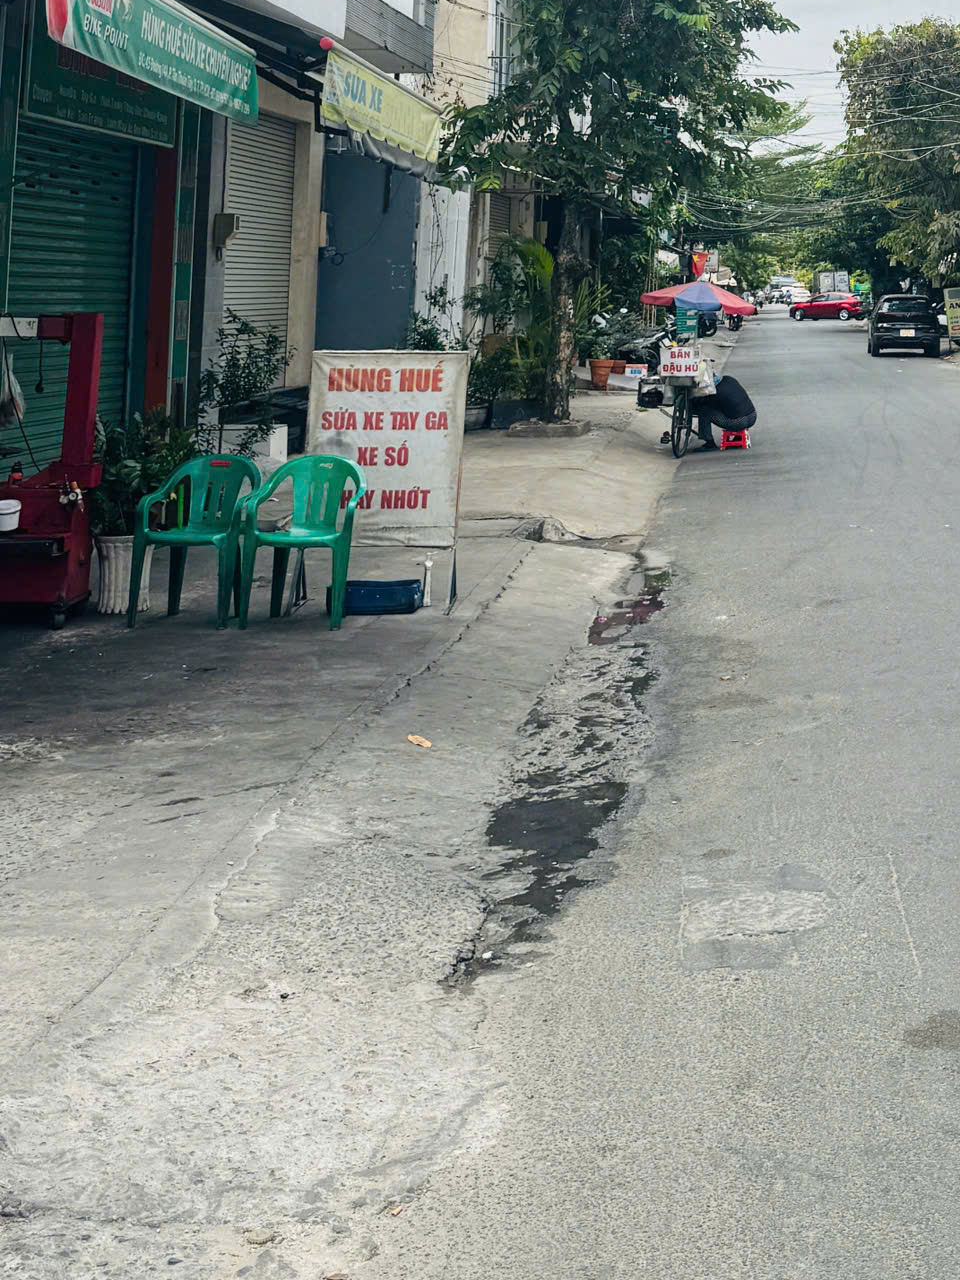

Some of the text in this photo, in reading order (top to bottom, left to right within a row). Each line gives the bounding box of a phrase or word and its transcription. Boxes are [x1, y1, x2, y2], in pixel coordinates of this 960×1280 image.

[84, 14, 128, 50] BIKE POINT
[141, 7, 165, 48] HÙNG
[196, 41, 206, 69] XE
[949, 302, 960, 310] AN
[327, 360, 444, 393] HÙNG HUẾ
[321, 407, 449, 431] SỬA XE TAY GA
[357, 440, 410, 467] XE SỐ
[380, 486, 431, 510] NHỚT
